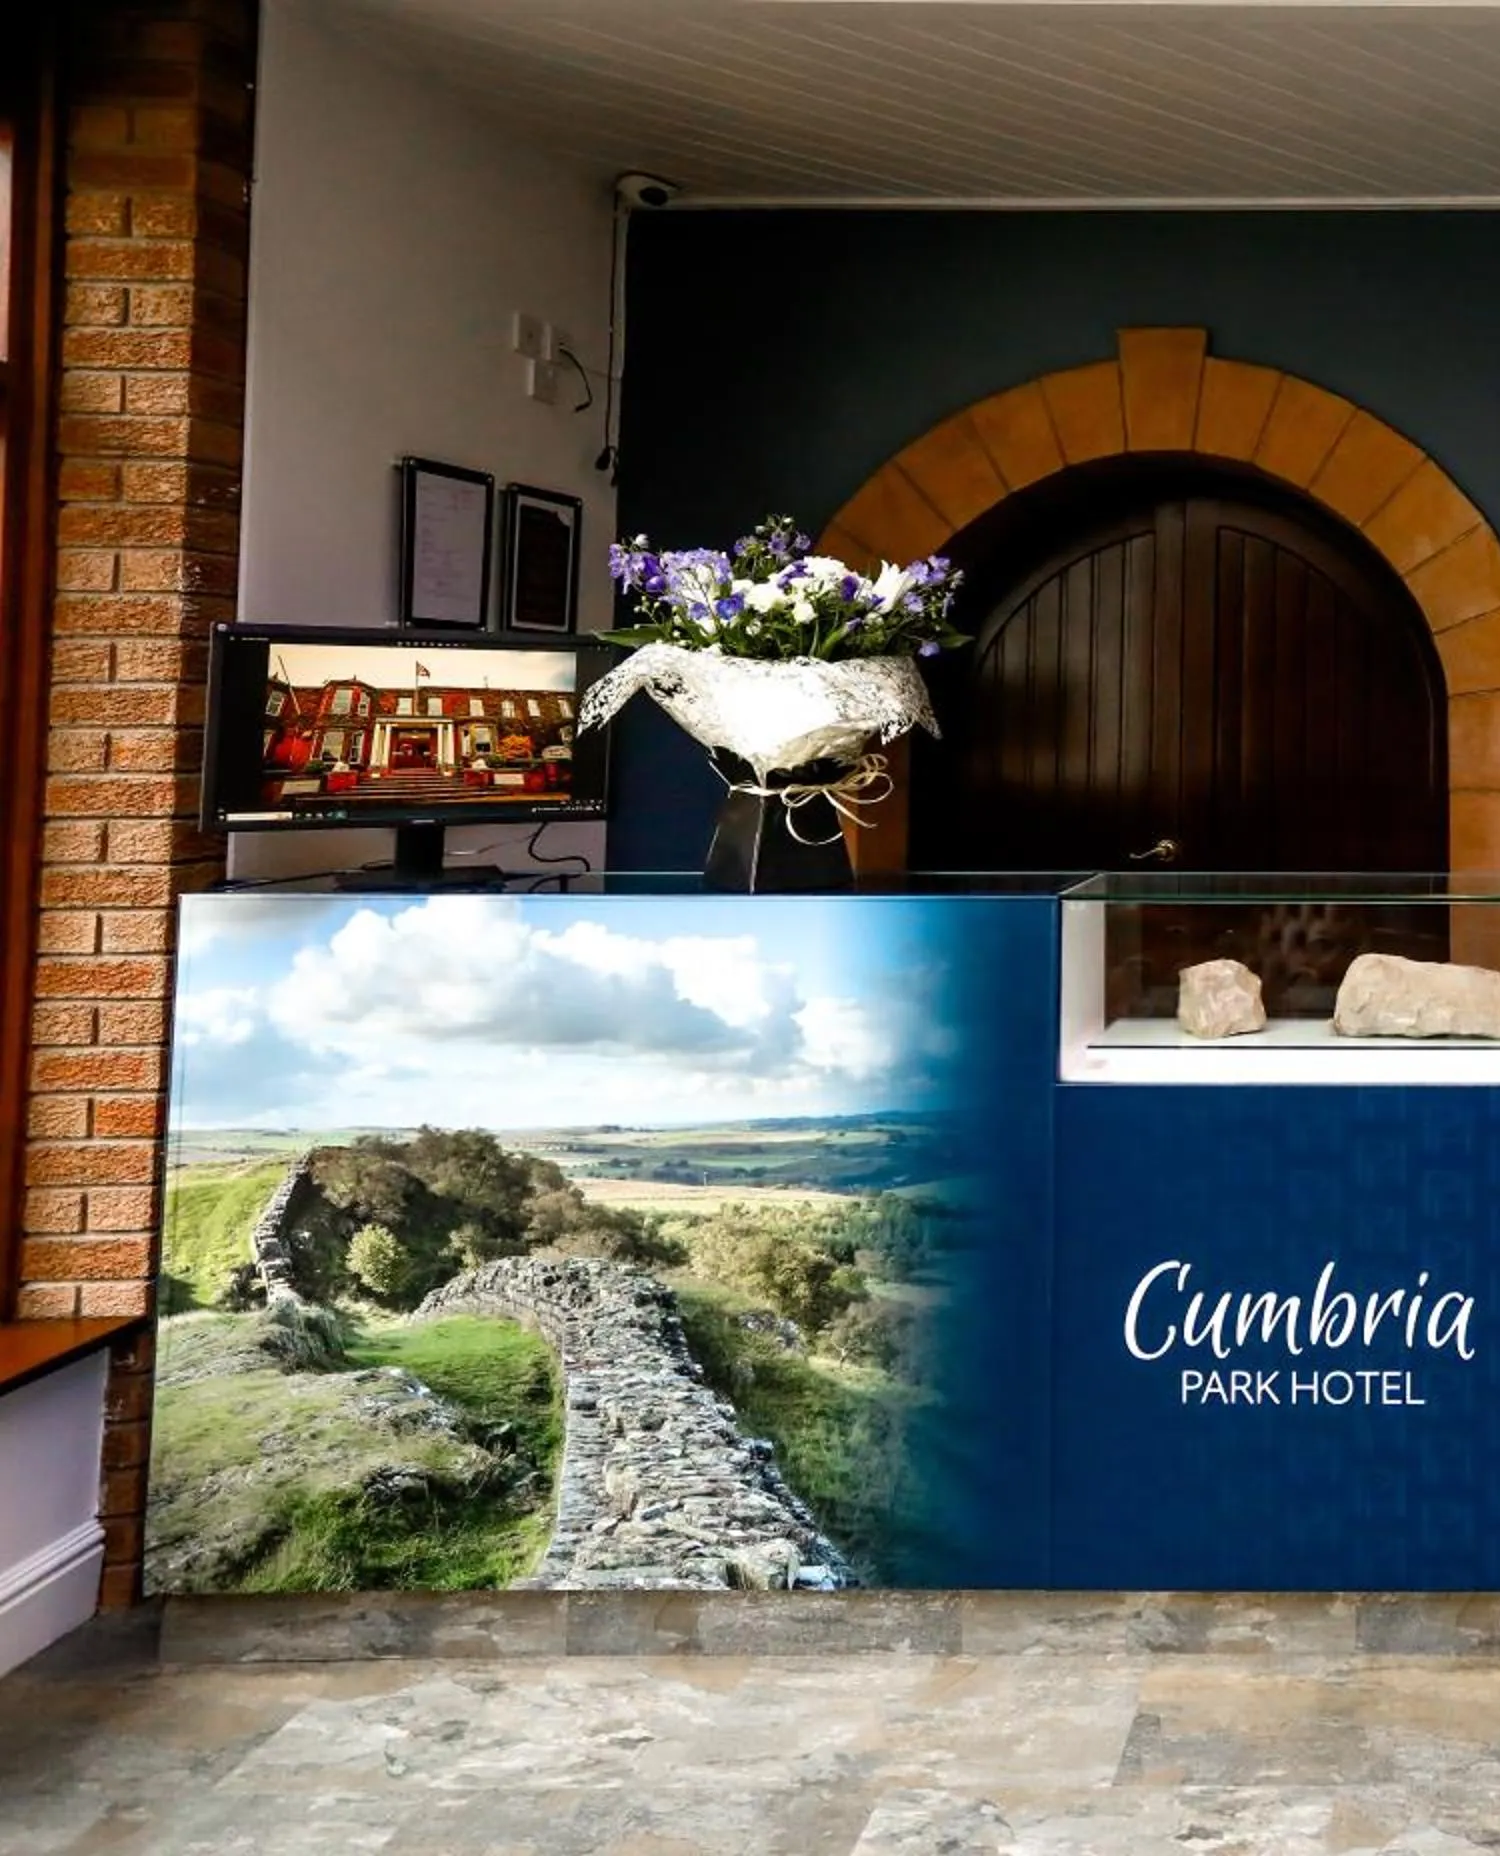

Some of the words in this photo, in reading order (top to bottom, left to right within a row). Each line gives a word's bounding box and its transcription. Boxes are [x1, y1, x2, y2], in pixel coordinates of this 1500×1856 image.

[1124, 1260, 1475, 1361] Cumbria
[1181, 1370, 1281, 1405] PARK
[1291, 1370, 1425, 1405] HOTEL
